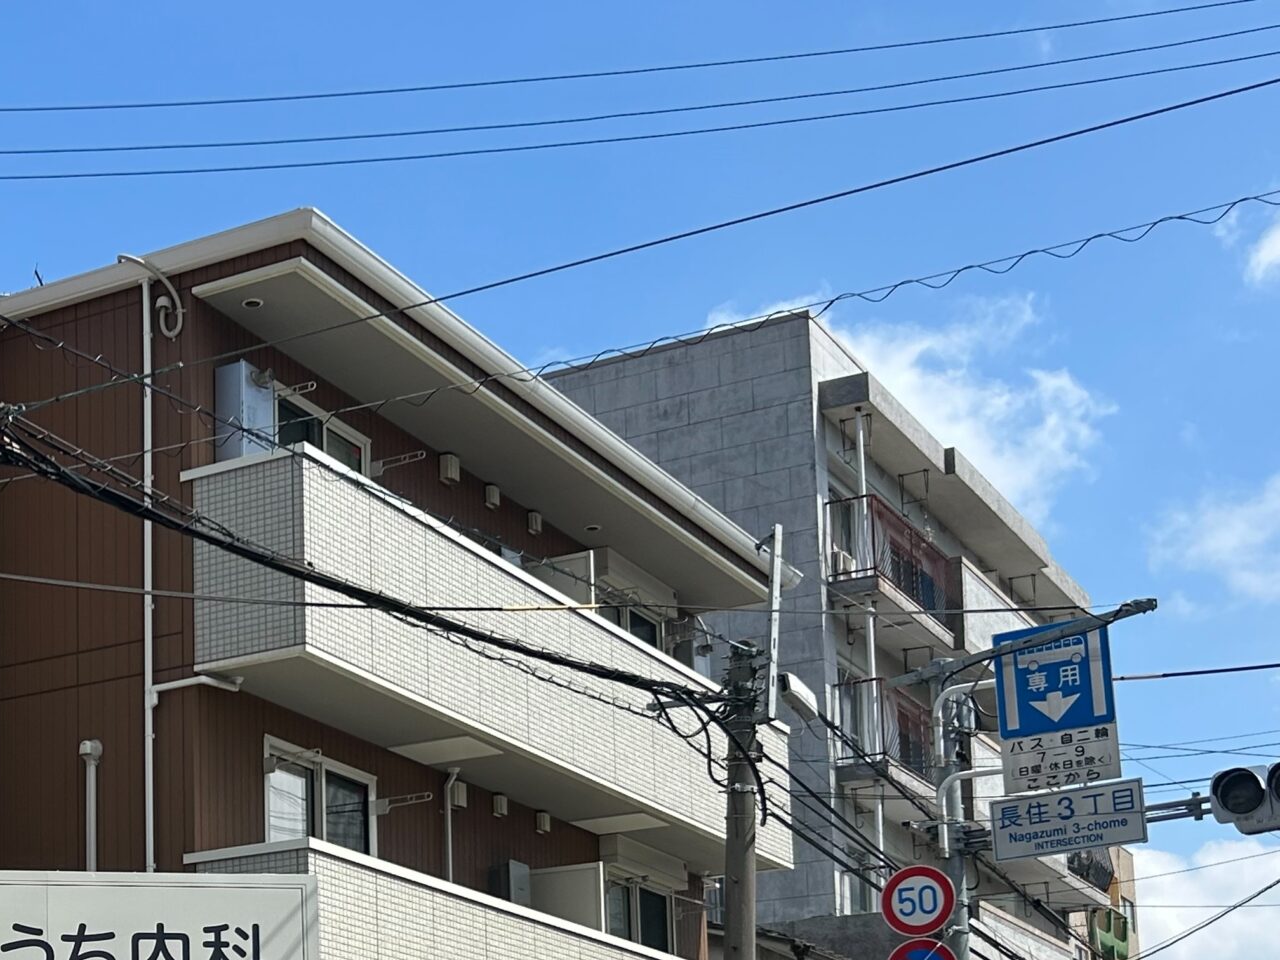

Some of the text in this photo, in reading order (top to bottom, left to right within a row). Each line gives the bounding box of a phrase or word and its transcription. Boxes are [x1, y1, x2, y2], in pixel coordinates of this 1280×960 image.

[1026, 664, 1081, 693] 専用
[1010, 726, 1110, 754] バス・自二輪
[1027, 769, 1101, 791] ここから
[999, 788, 1136, 830] 長住3丁目
[1009, 818, 1129, 844] Nagazumi 3-chome
[1034, 833, 1104, 851] INTERSECTION
[897, 884, 938, 917] 50
